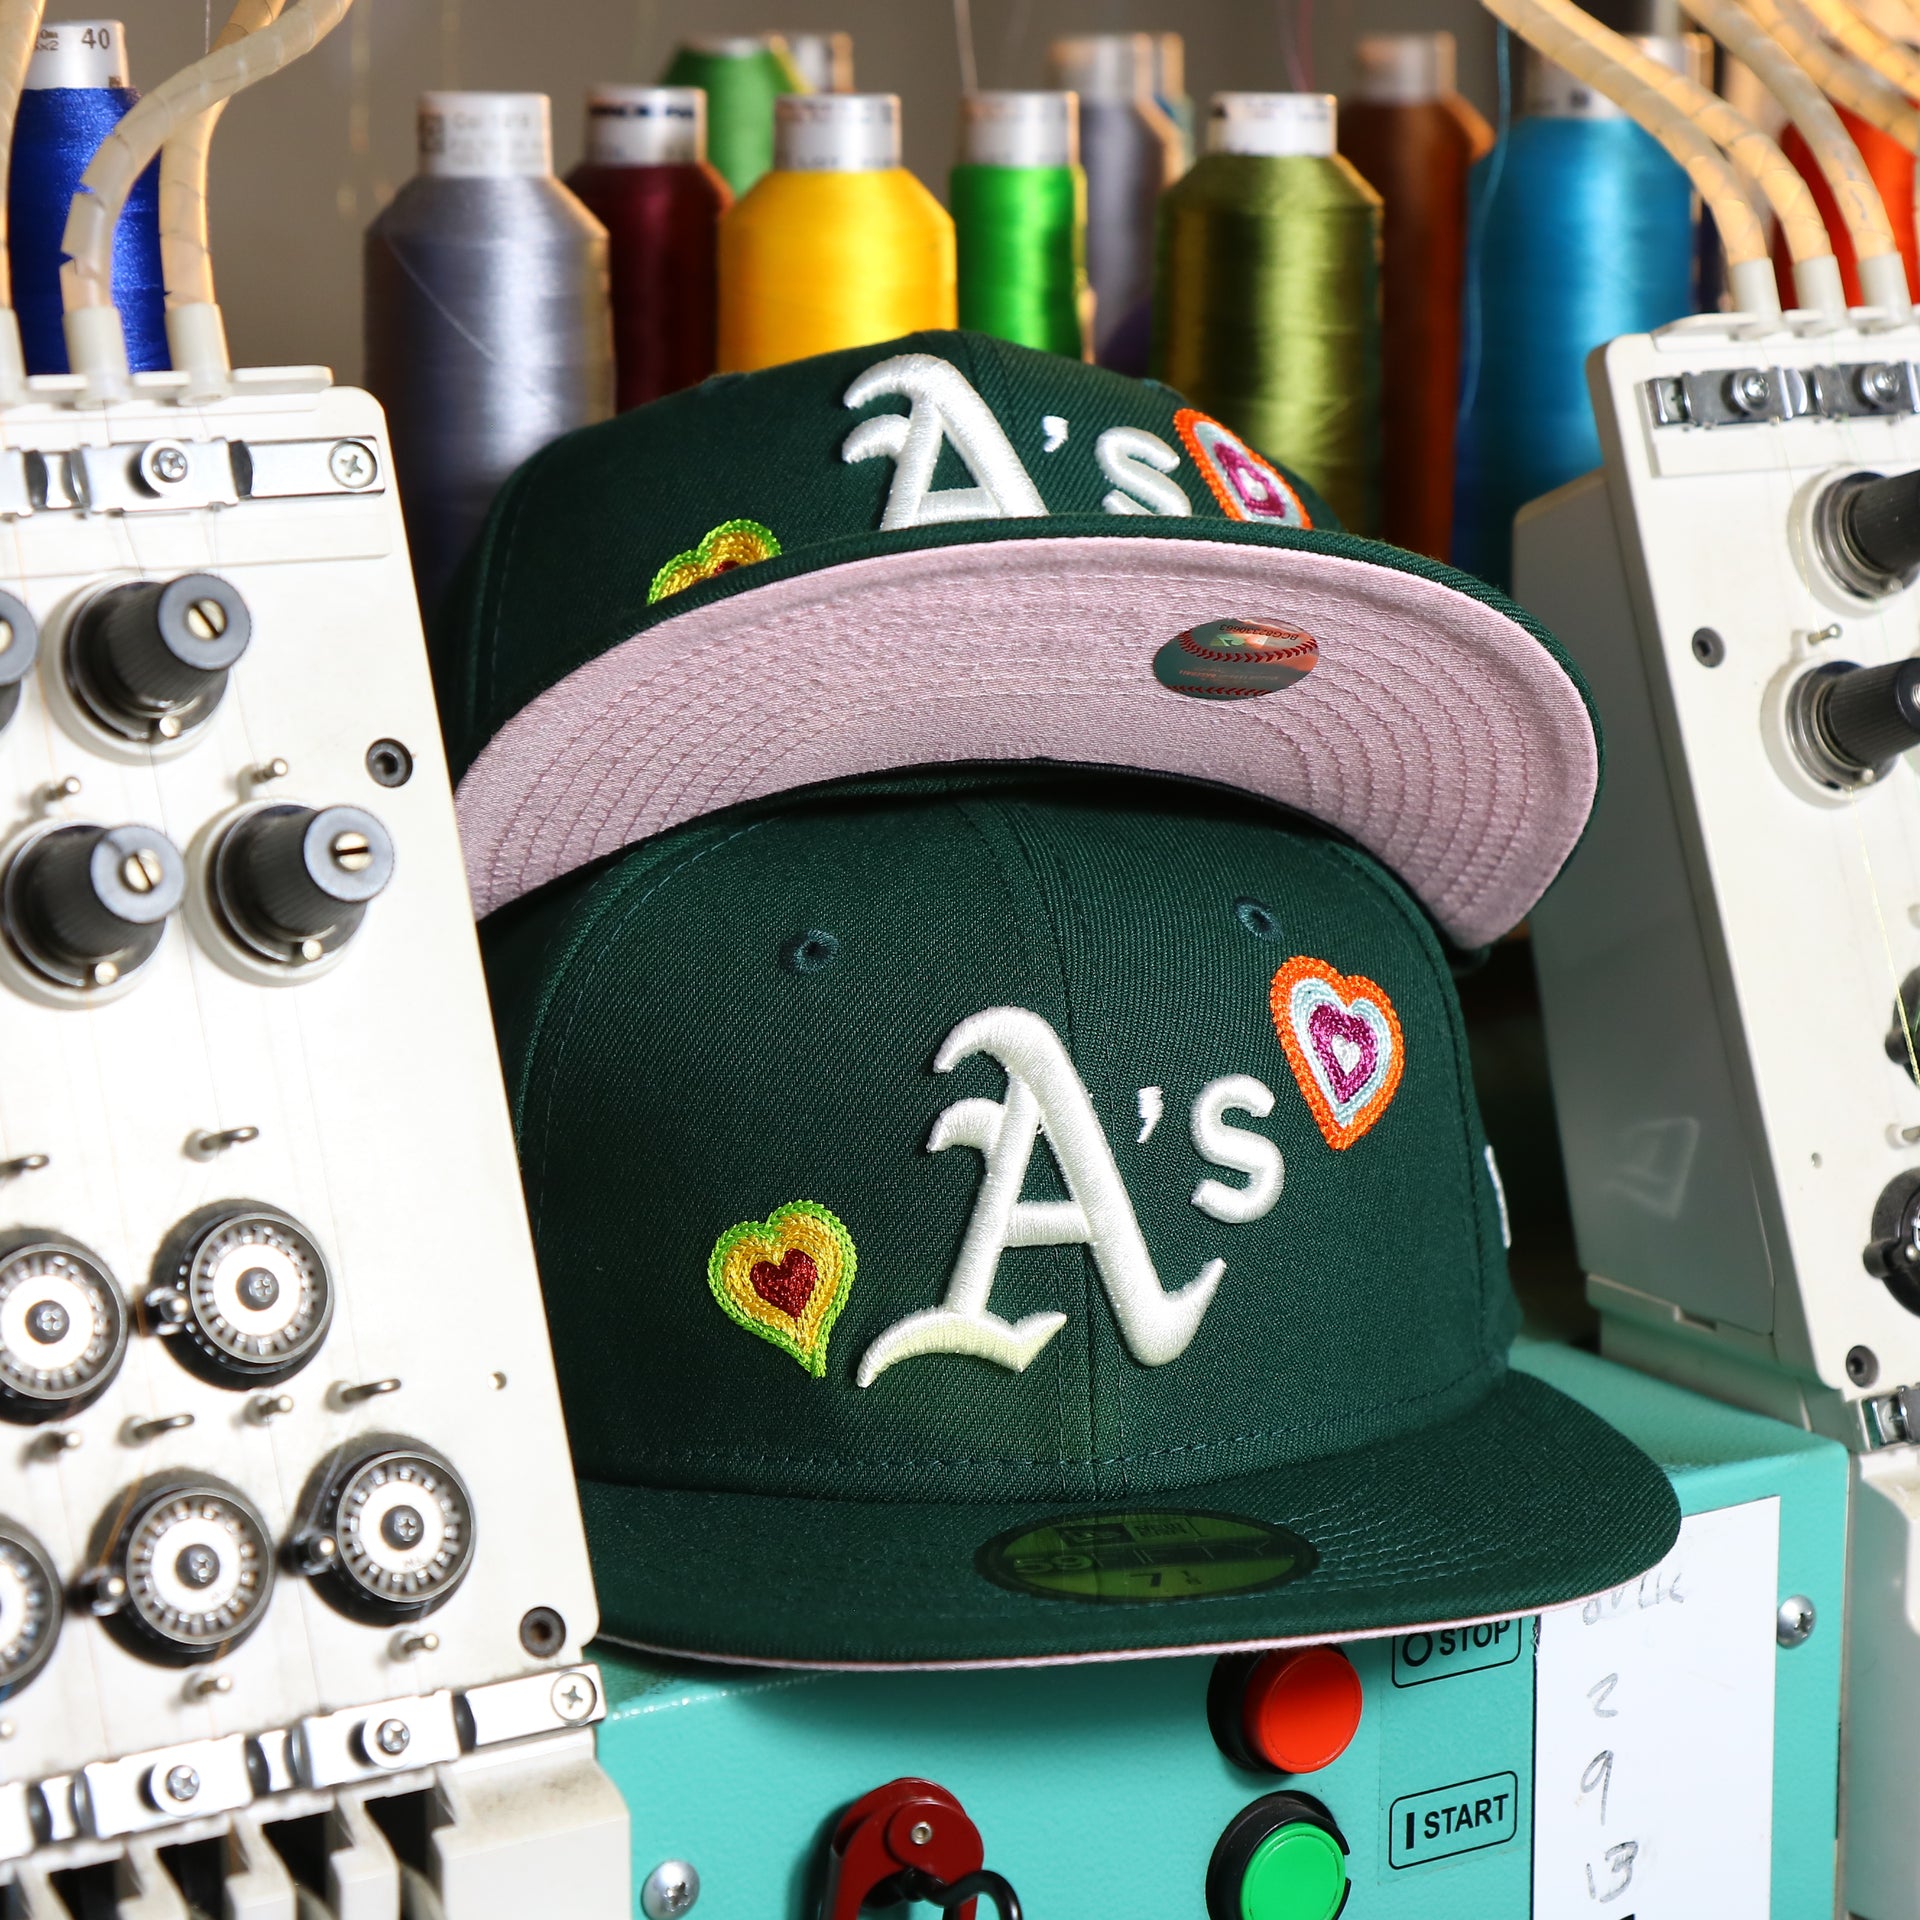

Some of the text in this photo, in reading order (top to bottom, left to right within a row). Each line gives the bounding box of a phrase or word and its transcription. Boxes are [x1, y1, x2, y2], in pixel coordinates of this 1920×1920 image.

[81, 27, 111, 50] 40
[856, 1005, 1286, 1389] A's
[1439, 1618, 1512, 1657] STOP
[1586, 1671, 1620, 1719] 2
[1579, 1748, 1615, 1827] 9
[1423, 1792, 1509, 1841] START
[1584, 1839, 1641, 1904] 13
